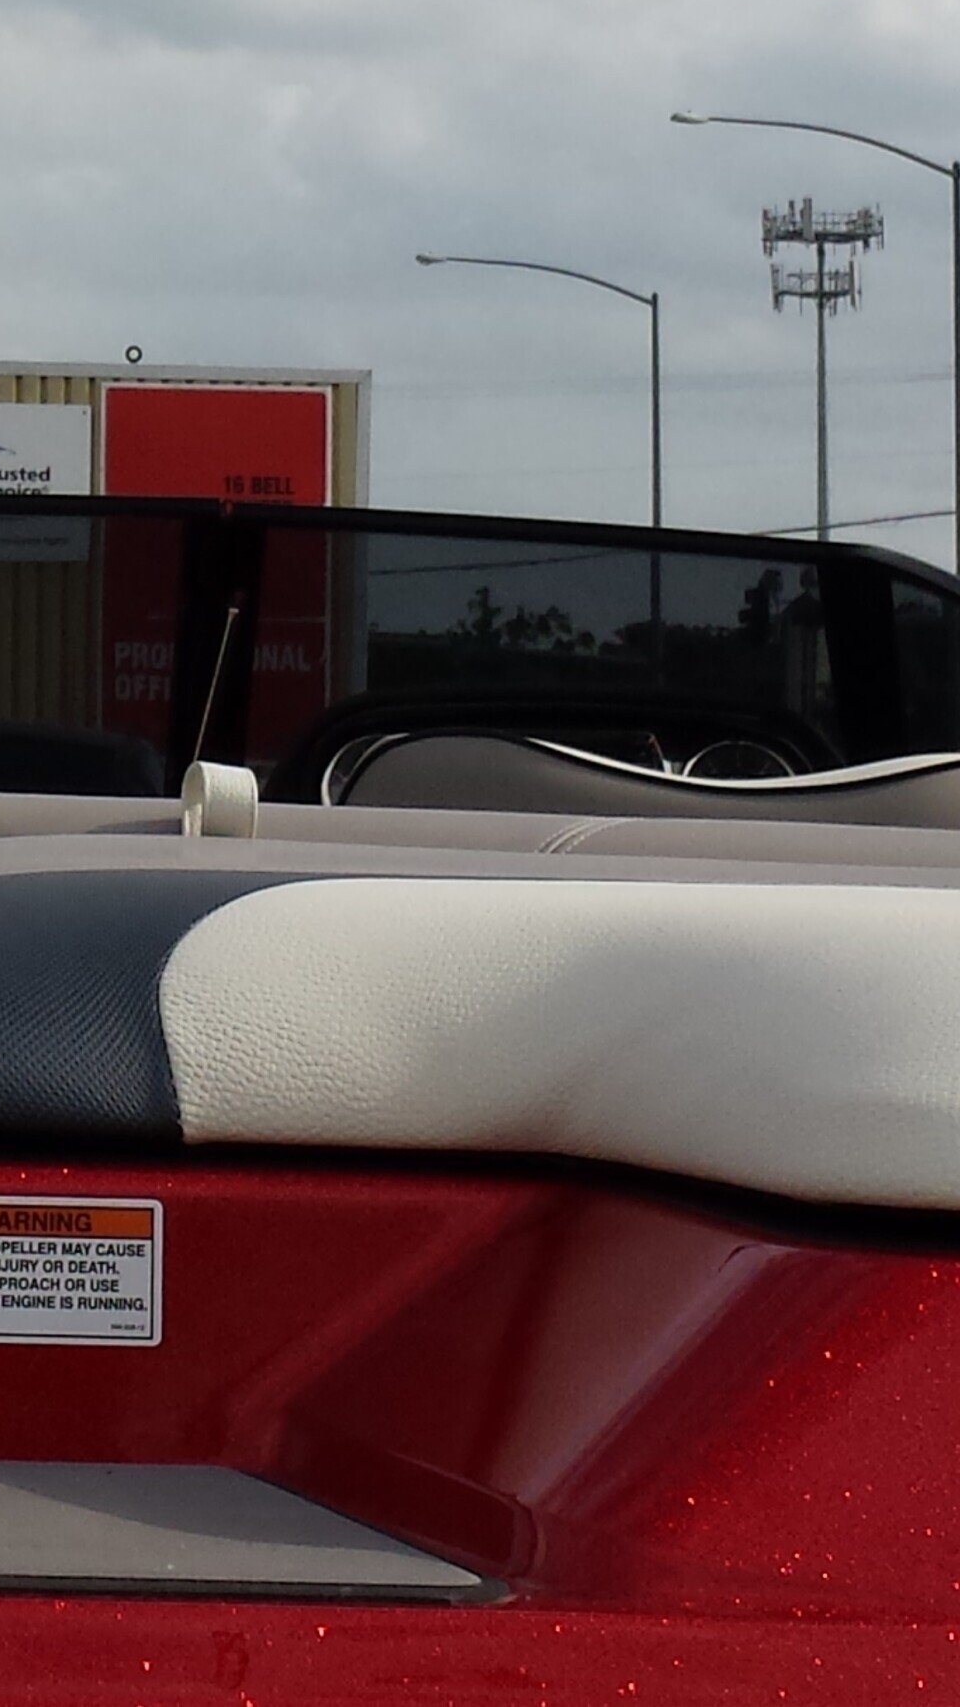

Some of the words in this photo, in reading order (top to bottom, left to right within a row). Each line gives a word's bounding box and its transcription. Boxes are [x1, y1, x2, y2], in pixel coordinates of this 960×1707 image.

[61, 1242, 91, 1255] MAY
[95, 1243, 146, 1257] CAUSE
[42, 1260, 64, 1273] OR
[68, 1260, 120, 1275] DEATH.
[64, 1278, 86, 1292] OR
[90, 1279, 120, 1293] USE
[1, 1295, 56, 1309] ENGINE
[60, 1296, 74, 1309] IS
[77, 1297, 148, 1312] RUNNING.
